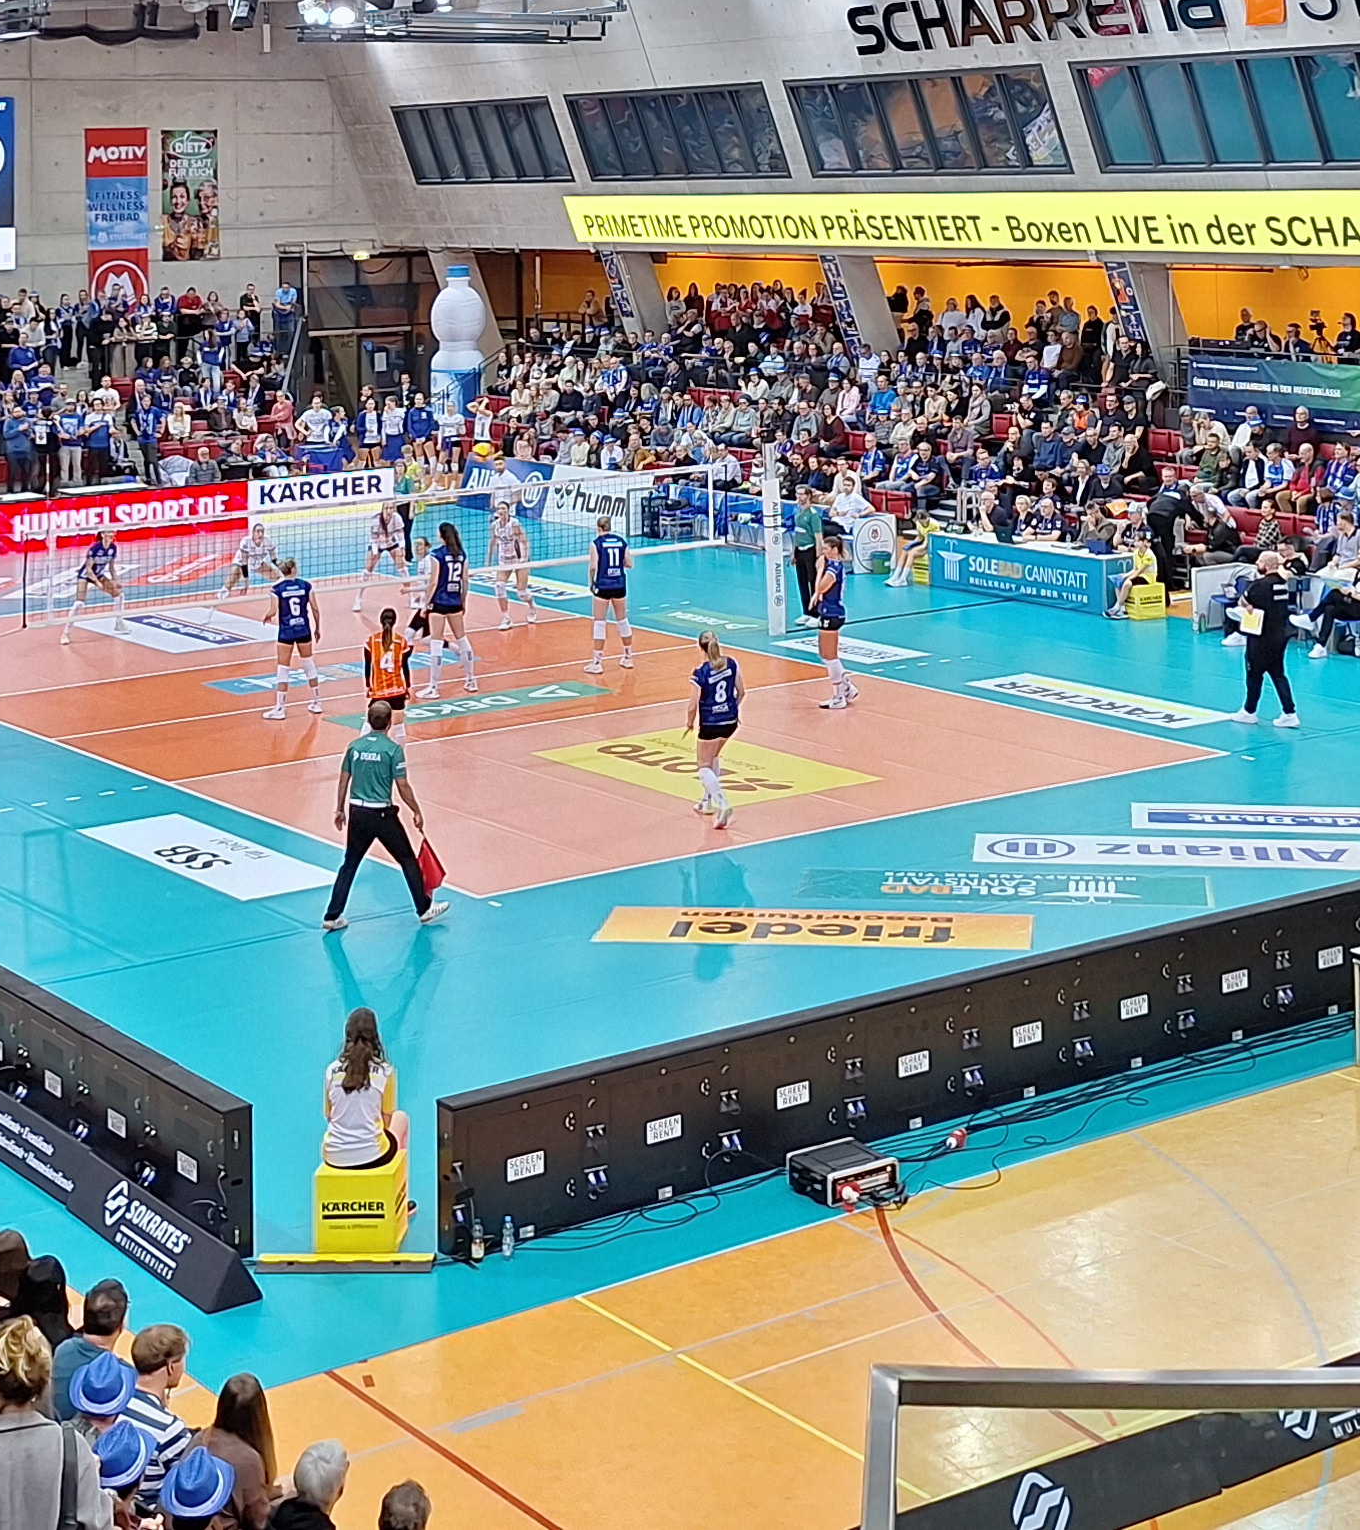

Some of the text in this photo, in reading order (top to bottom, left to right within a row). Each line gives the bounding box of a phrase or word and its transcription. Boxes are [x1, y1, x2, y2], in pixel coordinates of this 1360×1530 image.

[87, 145, 147, 164] MOTIV
[175, 143, 208, 153] DIETZ
[170, 159, 213, 168] DER SAFT
[188, 168, 214, 177] EUCH
[95, 191, 140, 201] FITNESS
[89, 201, 145, 212] WELLNESS
[95, 213, 140, 223] FREIBAD
[584, 214, 687, 238] PRIMETIME
[689, 215, 817, 240] PROMOTION
[821, 209, 984, 243] PRÄSENTIERT
[1006, 215, 1089, 243] Boxen
[1096, 216, 1165, 244] LIVE
[1169, 215, 1199, 245] in
[1203, 215, 1257, 246] der
[259, 474, 383, 505] KÄRCHER
[13, 494, 227, 542] HUMMELSPORT.DE
[607, 547, 621, 568] 11
[447, 562, 462, 582] 12
[968, 555, 1088, 590] SOLEBAD CANNSTATT
[969, 576, 1017, 592] HEILKRAFT
[1020, 585, 1037, 596] AUS
[1040, 588, 1059, 599] DER
[289, 598, 301, 617] 6
[380, 651, 394, 673] 4
[714, 680, 728, 703] 8
[404, 695, 521, 719] DEKR
[993, 680, 1192, 724] KÄRCHER
[153, 844, 233, 871] SSB
[1094, 841, 1352, 864] Allianz
[881, 875, 1038, 887] CANNSTATT
[880, 884, 1037, 897] SOLEBAD
[680, 910, 954, 924] Beschriftungen
[668, 920, 956, 944] friedel
[900, 1052, 928, 1067] SCREEN
[904, 1061, 924, 1074] RENT
[778, 1083, 808, 1099] SCREEN
[782, 1094, 803, 1107] RENT
[648, 1116, 680, 1133] SCREEN
[652, 1127, 675, 1141] RENT
[509, 1152, 543, 1170] SCREEN
[513, 1164, 537, 1178] RENT
[321, 1201, 385, 1213] KÄRCHER
[124, 1200, 190, 1255] SOKRATES
[114, 1231, 175, 1282] MULTISERVICES
